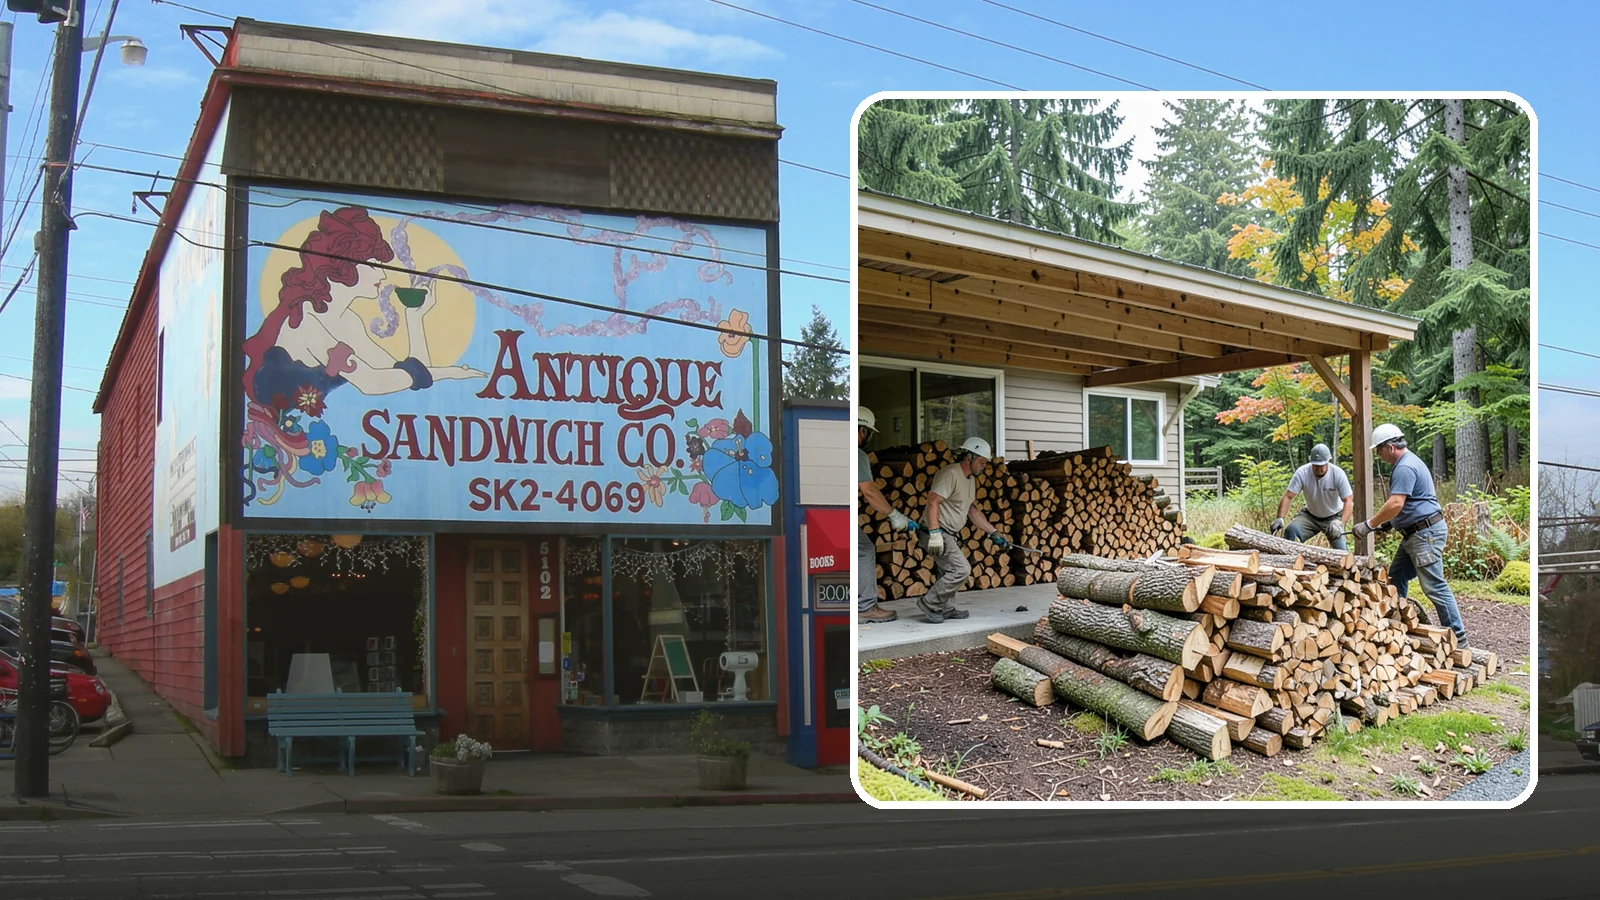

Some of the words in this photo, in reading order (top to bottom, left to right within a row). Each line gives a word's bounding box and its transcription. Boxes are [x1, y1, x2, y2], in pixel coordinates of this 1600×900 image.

[476, 329, 724, 421] ANTIQUE
[361, 409, 604, 467] SANDWICH
[617, 422, 685, 469] CO.
[468, 478, 646, 513] SK2-4069
[539, 542, 552, 600] 5102
[809, 555, 835, 569] BOOKS
